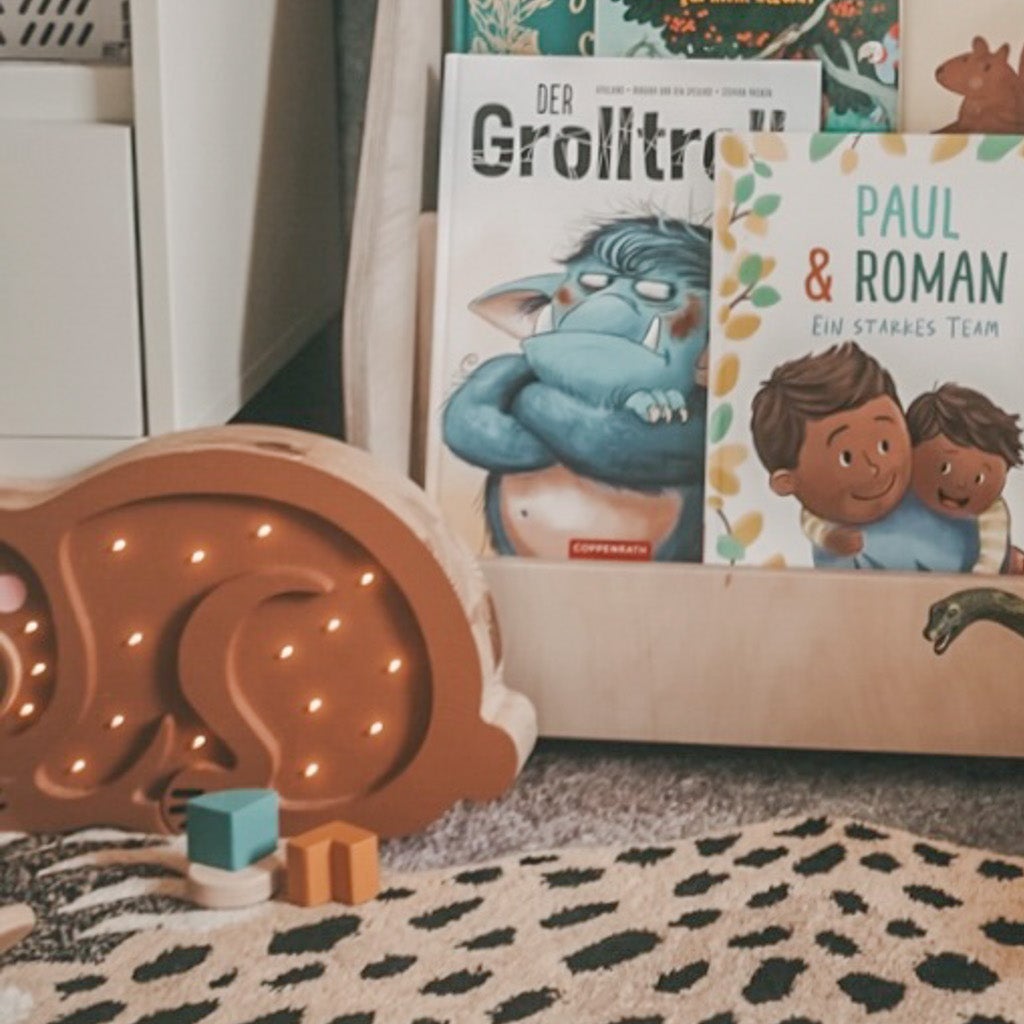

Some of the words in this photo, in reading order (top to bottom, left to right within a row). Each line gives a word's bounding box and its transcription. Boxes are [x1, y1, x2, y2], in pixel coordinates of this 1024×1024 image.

[536, 82, 574, 115] DER
[855, 184, 960, 240] PAUL
[804, 247, 834, 303] &
[855, 249, 1008, 304] ROMAN
